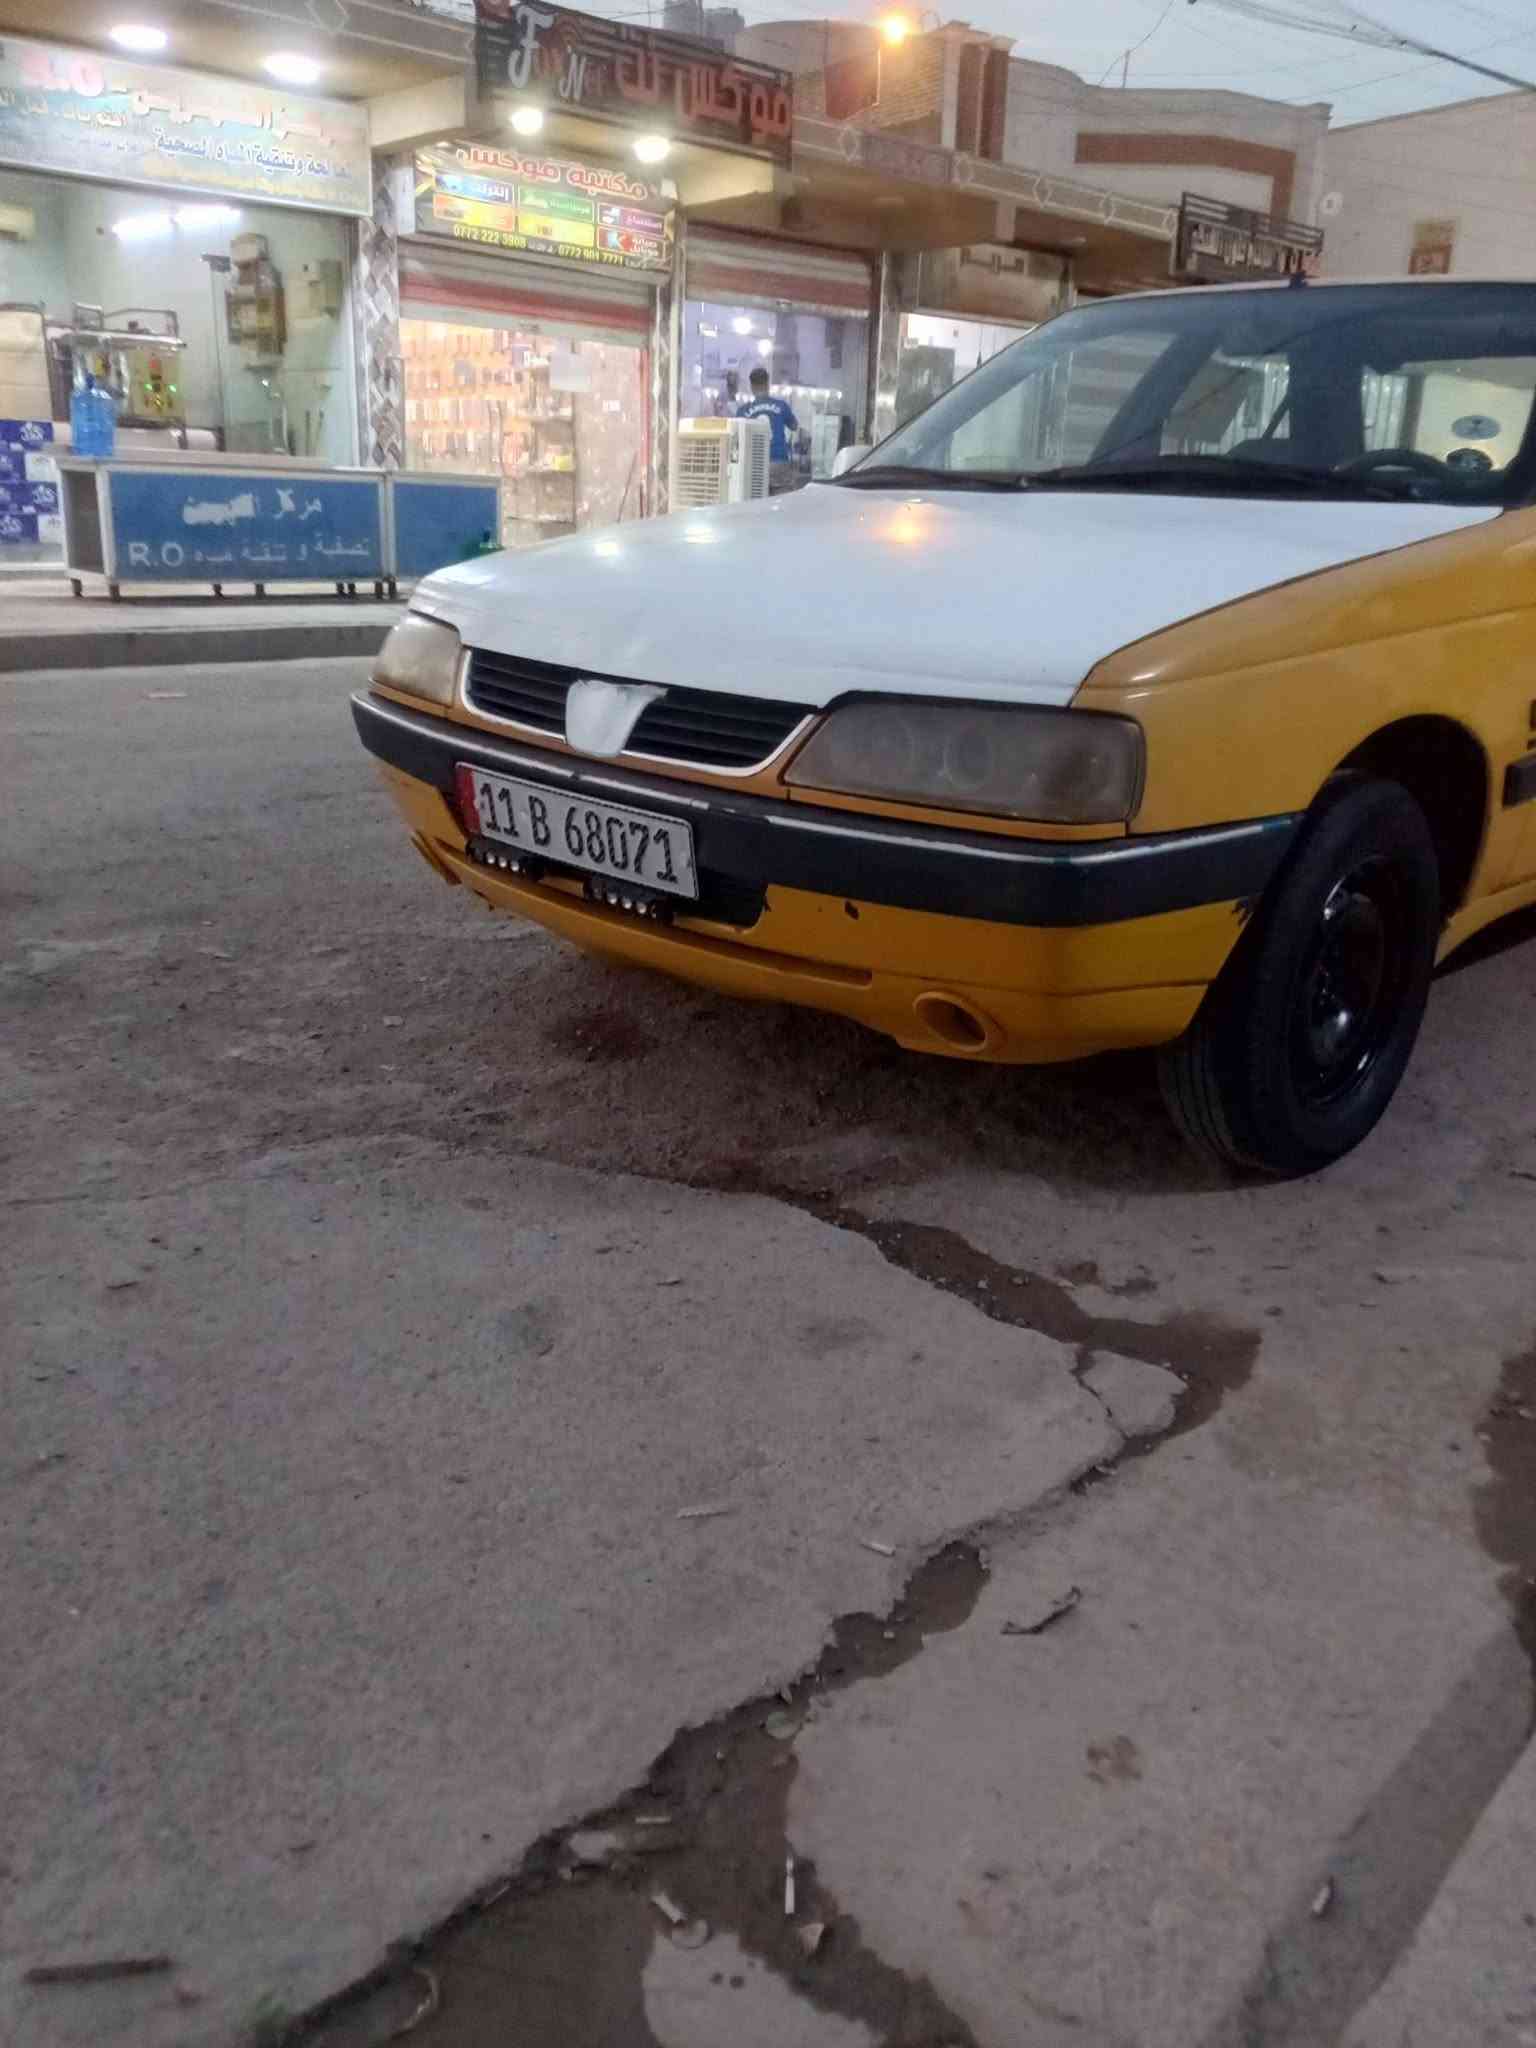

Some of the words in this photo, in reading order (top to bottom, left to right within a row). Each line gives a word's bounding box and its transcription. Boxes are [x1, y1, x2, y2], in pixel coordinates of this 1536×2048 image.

[566, 163, 648, 201] مكتبة
[127, 542, 185, 568] R.O
[478, 782, 519, 838] 11
[528, 795, 550, 846] B
[563, 805, 678, 884] 68071
